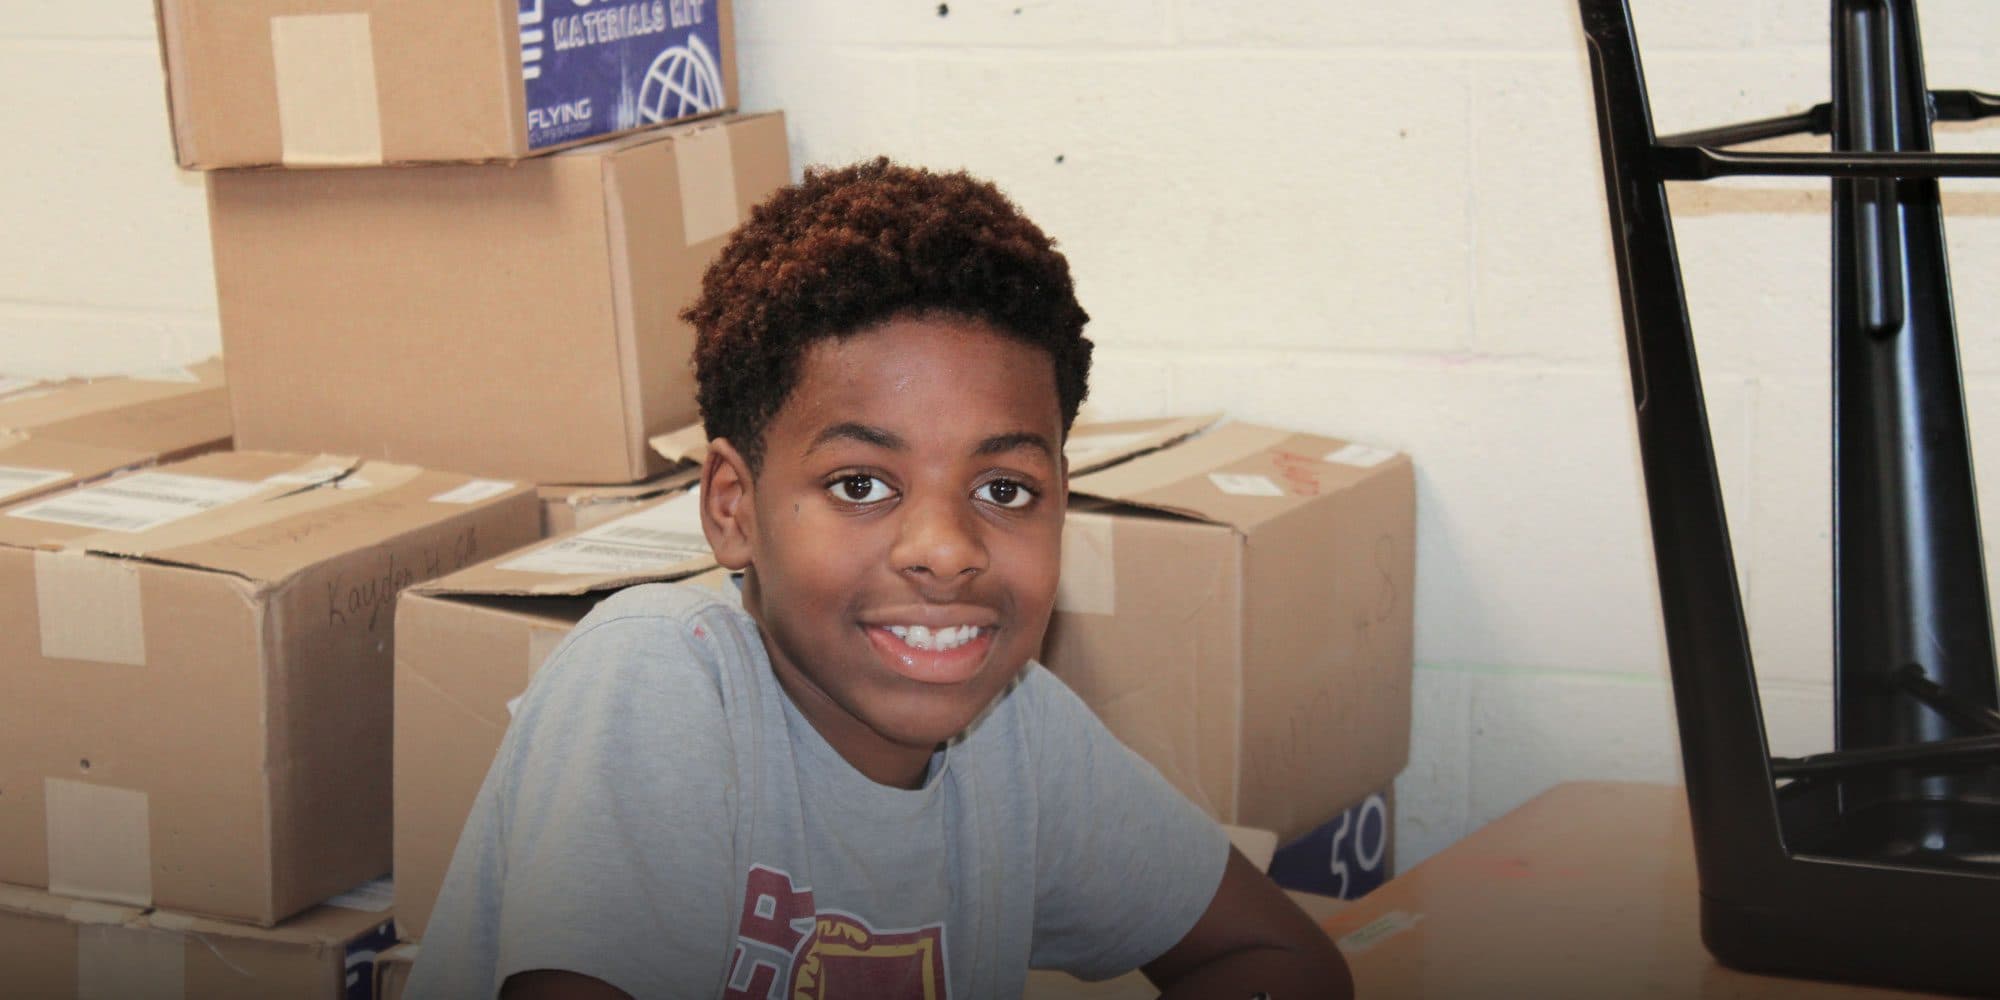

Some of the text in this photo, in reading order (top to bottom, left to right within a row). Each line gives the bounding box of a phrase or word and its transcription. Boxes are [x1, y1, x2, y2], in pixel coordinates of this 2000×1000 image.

[552, 0, 704, 50] MATERIALS KIT
[527, 97, 592, 131] FLYING
[327, 551, 413, 632] Kayden
